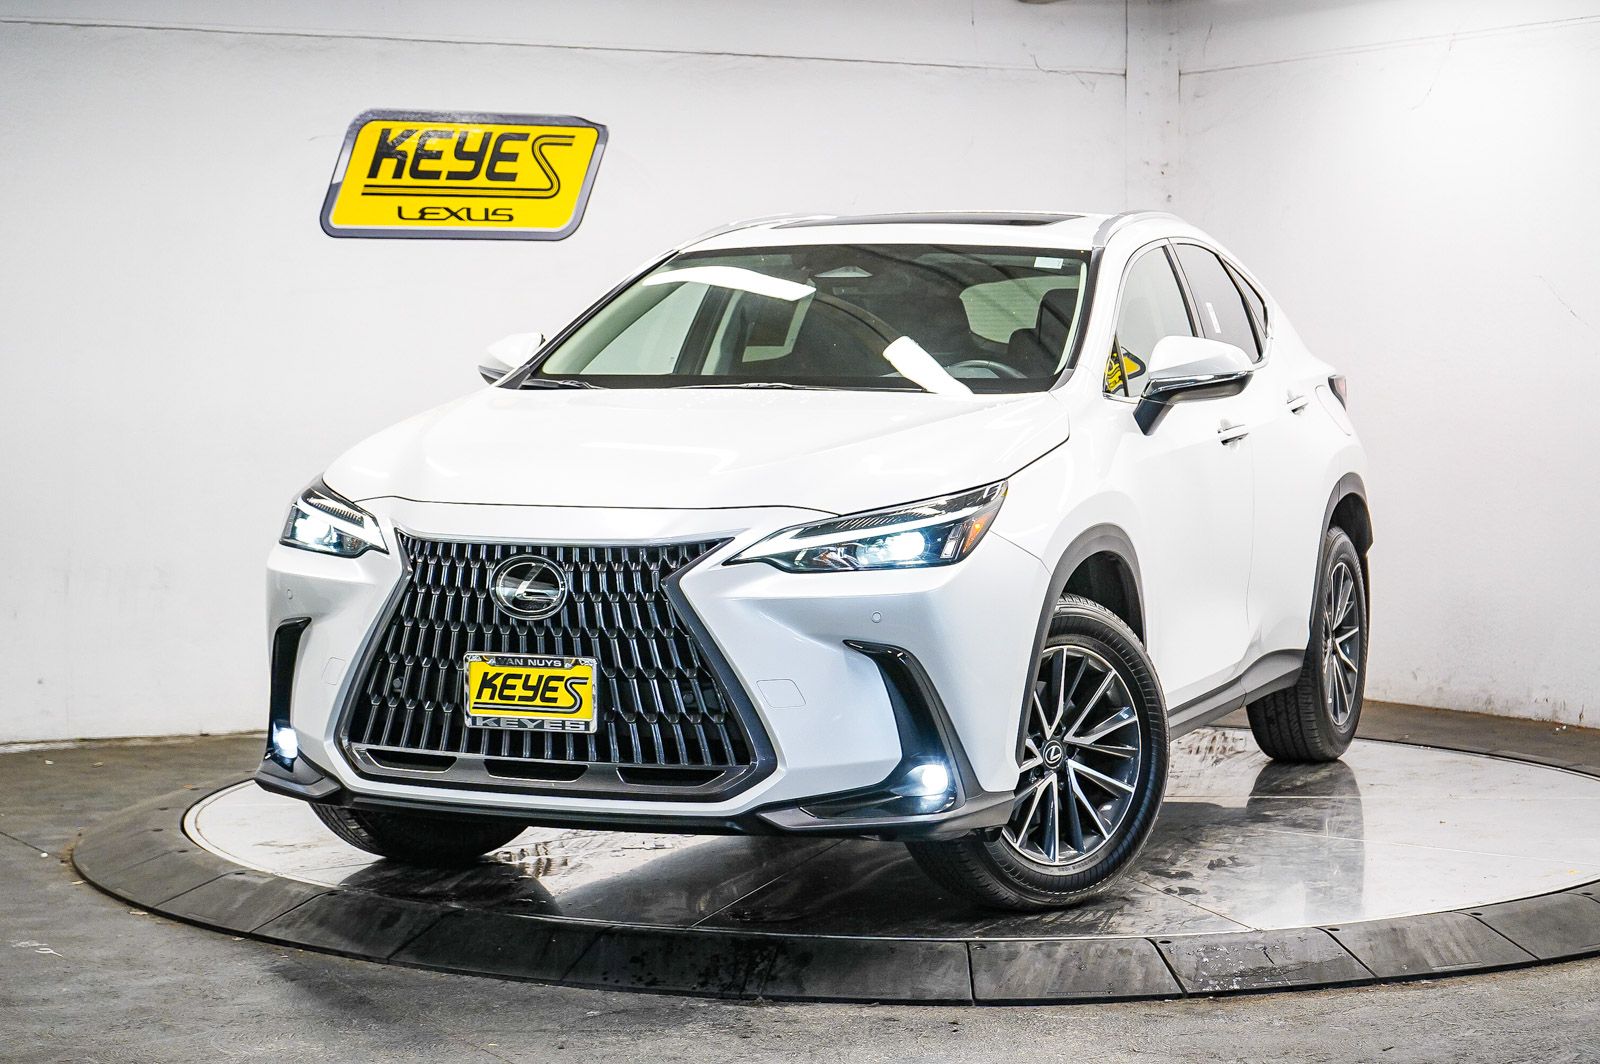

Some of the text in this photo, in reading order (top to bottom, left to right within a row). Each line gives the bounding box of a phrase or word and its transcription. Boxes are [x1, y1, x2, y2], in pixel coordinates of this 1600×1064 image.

[361, 128, 576, 199] KEYES
[397, 205, 514, 222] LEXUS
[527, 658, 562, 668] NUYS
[472, 671, 589, 714] KEYES
[475, 716, 586, 731] KEYES
